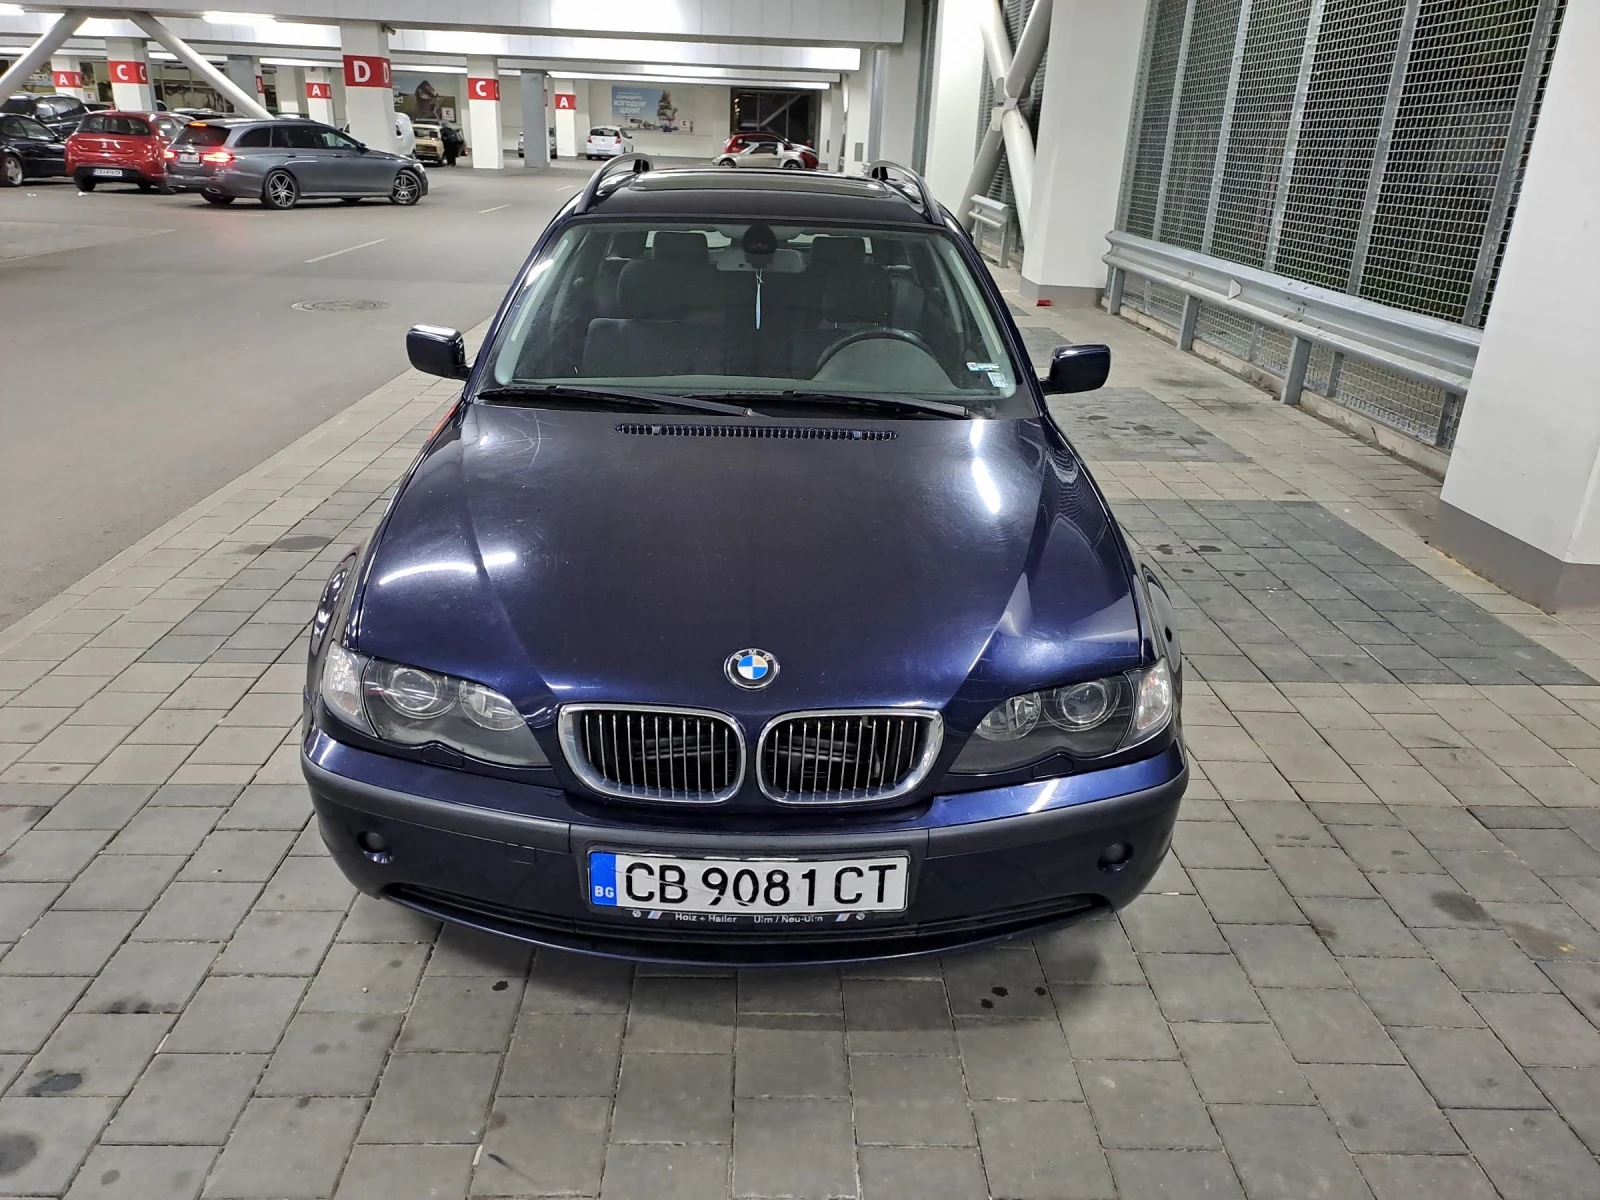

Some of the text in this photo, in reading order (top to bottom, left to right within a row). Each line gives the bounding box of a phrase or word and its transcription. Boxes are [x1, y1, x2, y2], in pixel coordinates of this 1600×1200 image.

[117, 64, 129, 81] C
[139, 65, 147, 81] C
[353, 60, 371, 83] D
[59, 73, 69, 86] A
[311, 84, 321, 96] A
[476, 80, 487, 97] C
[560, 96, 569, 108] A
[734, 649, 772, 661] BMW
[625, 862, 897, 906] CB 9081 CT
[594, 885, 615, 898] BG
[753, 915, 771, 923] Ulm
